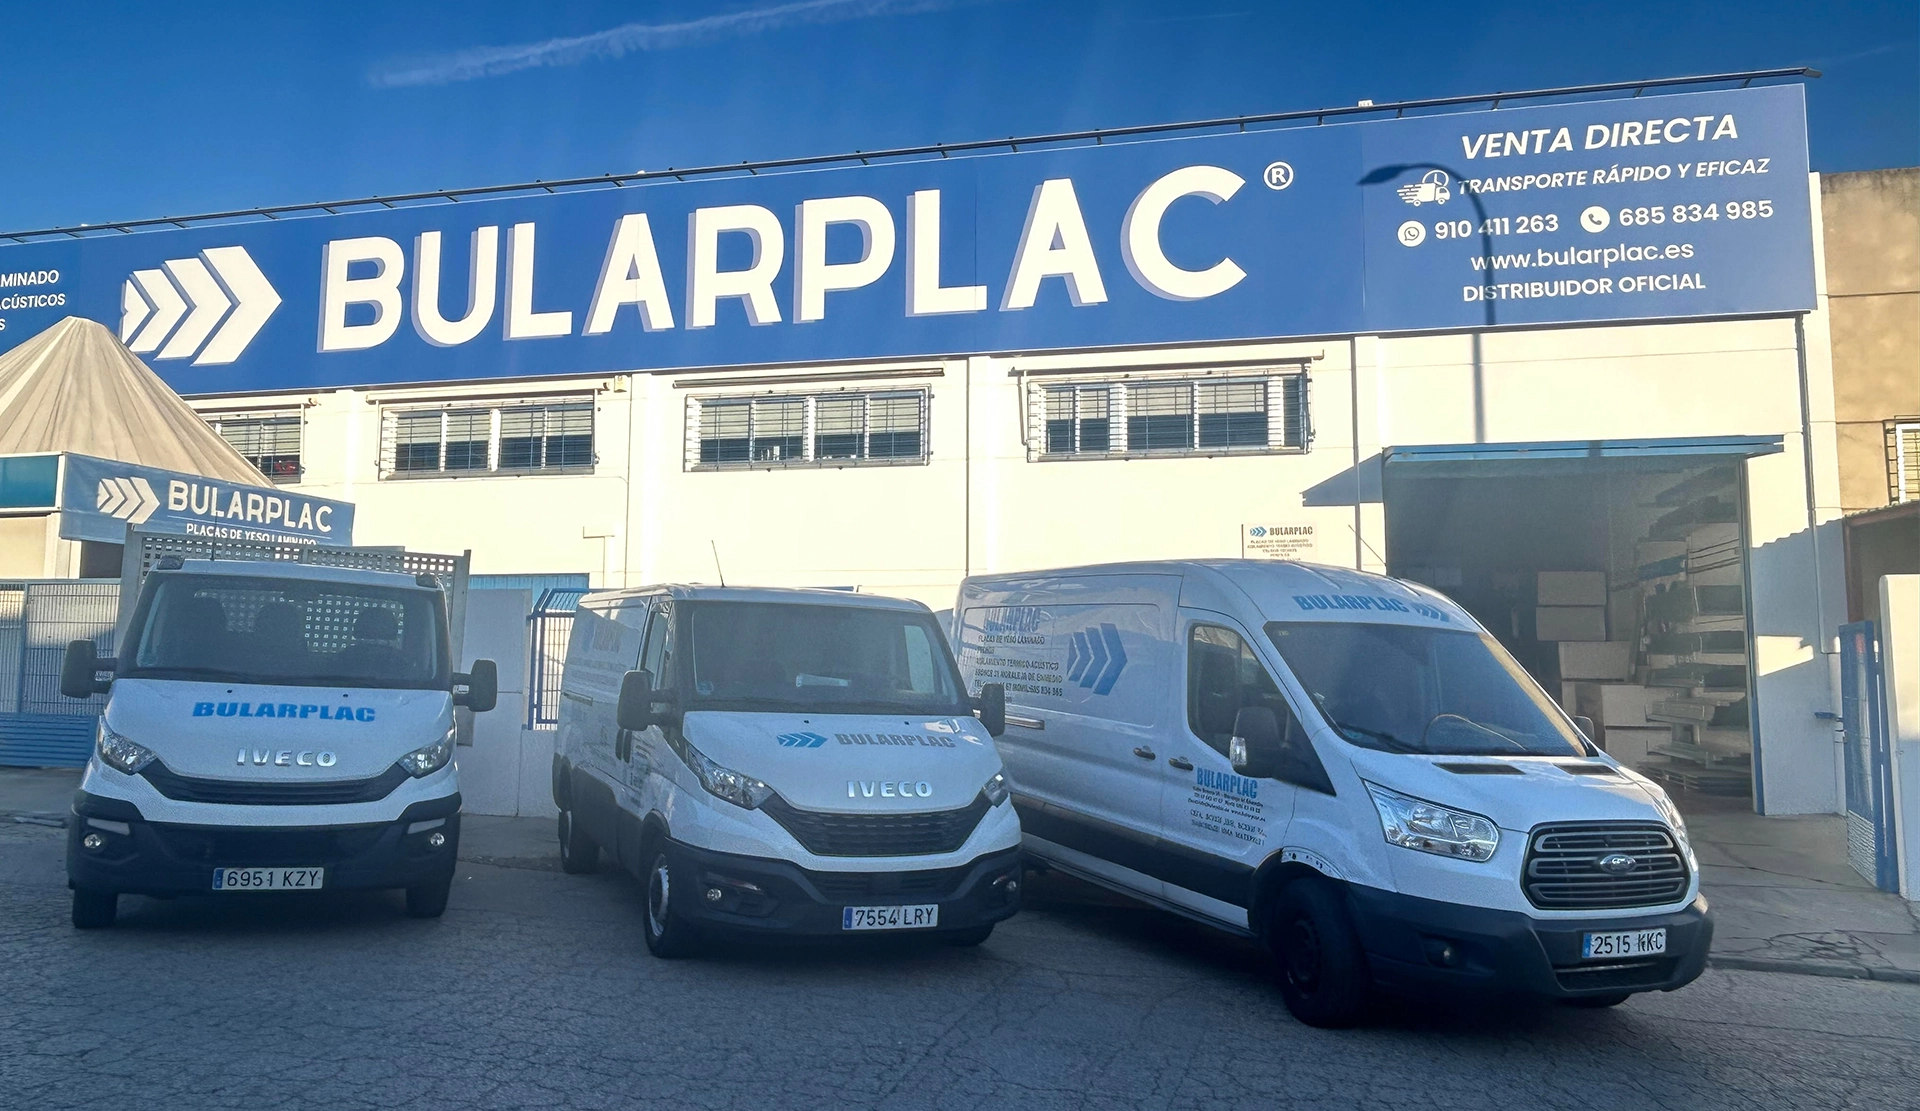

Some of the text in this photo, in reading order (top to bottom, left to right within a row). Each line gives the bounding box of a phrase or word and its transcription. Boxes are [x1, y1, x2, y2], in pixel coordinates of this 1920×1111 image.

[1461, 114, 1739, 161] VENTA DIRECTA
[1458, 158, 1771, 195] TRANSPORTE RÁPIDO Y EFICAZ
[1618, 199, 1774, 227] 685 834 985
[1434, 213, 1559, 240] 910 411 263
[318, 165, 1248, 353] BULARPLAC
[1470, 241, 1695, 272] www.bularplac.es
[1462, 271, 1706, 302] DISTRIBUIDOR OFICIAL
[0, 293, 66, 310] CÚSTICOS
[168, 479, 333, 533] BULARPLAC
[186, 523, 228, 539] PLACAS
[230, 529, 242, 540] DE
[1269, 526, 1313, 536] BULARPLAC
[1291, 594, 1410, 613] BULARPLAC
[192, 700, 376, 723] BULARPLAC
[833, 732, 957, 749] BULARPLAC
[236, 746, 337, 768] IVECO
[847, 780, 932, 799] IVECO
[1196, 767, 1258, 799] BULARPLAC
[226, 869, 319, 887] 6951 KZY
[854, 906, 935, 928] 7554 LRY
[1594, 934, 1631, 955] 2515
